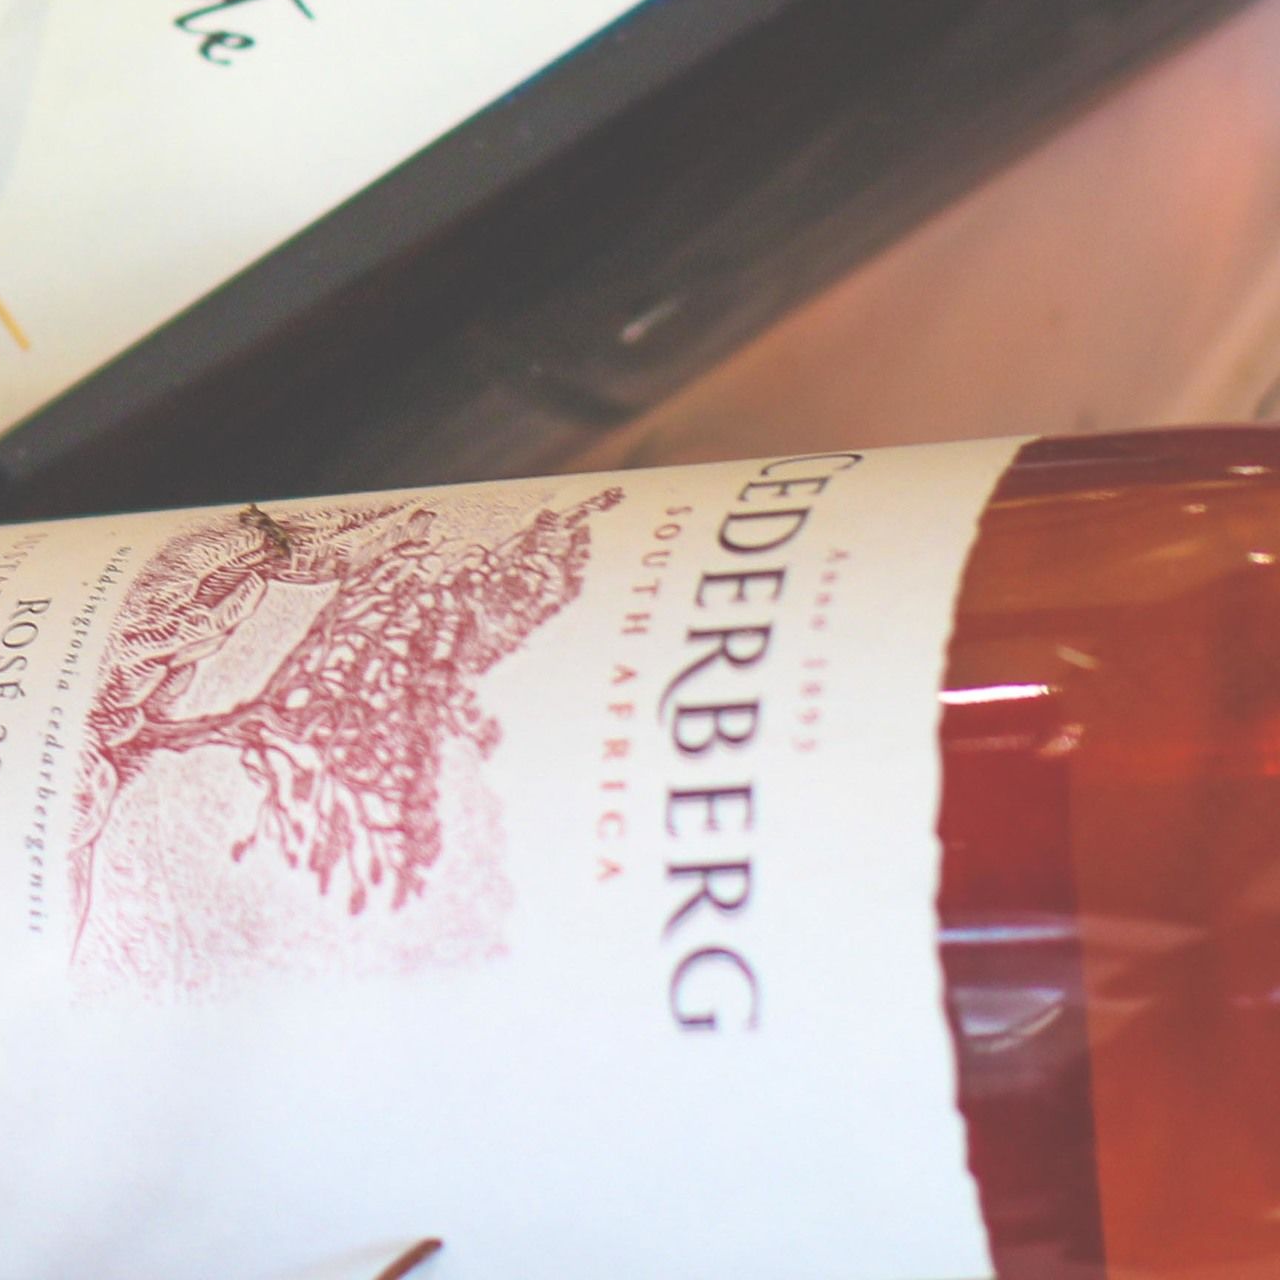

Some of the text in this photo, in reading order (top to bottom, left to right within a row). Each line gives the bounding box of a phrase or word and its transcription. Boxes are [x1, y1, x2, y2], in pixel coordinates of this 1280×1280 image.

[595, 505, 693, 886] SOUTH AFRICA
[658, 453, 866, 1035] CEDERBERG
